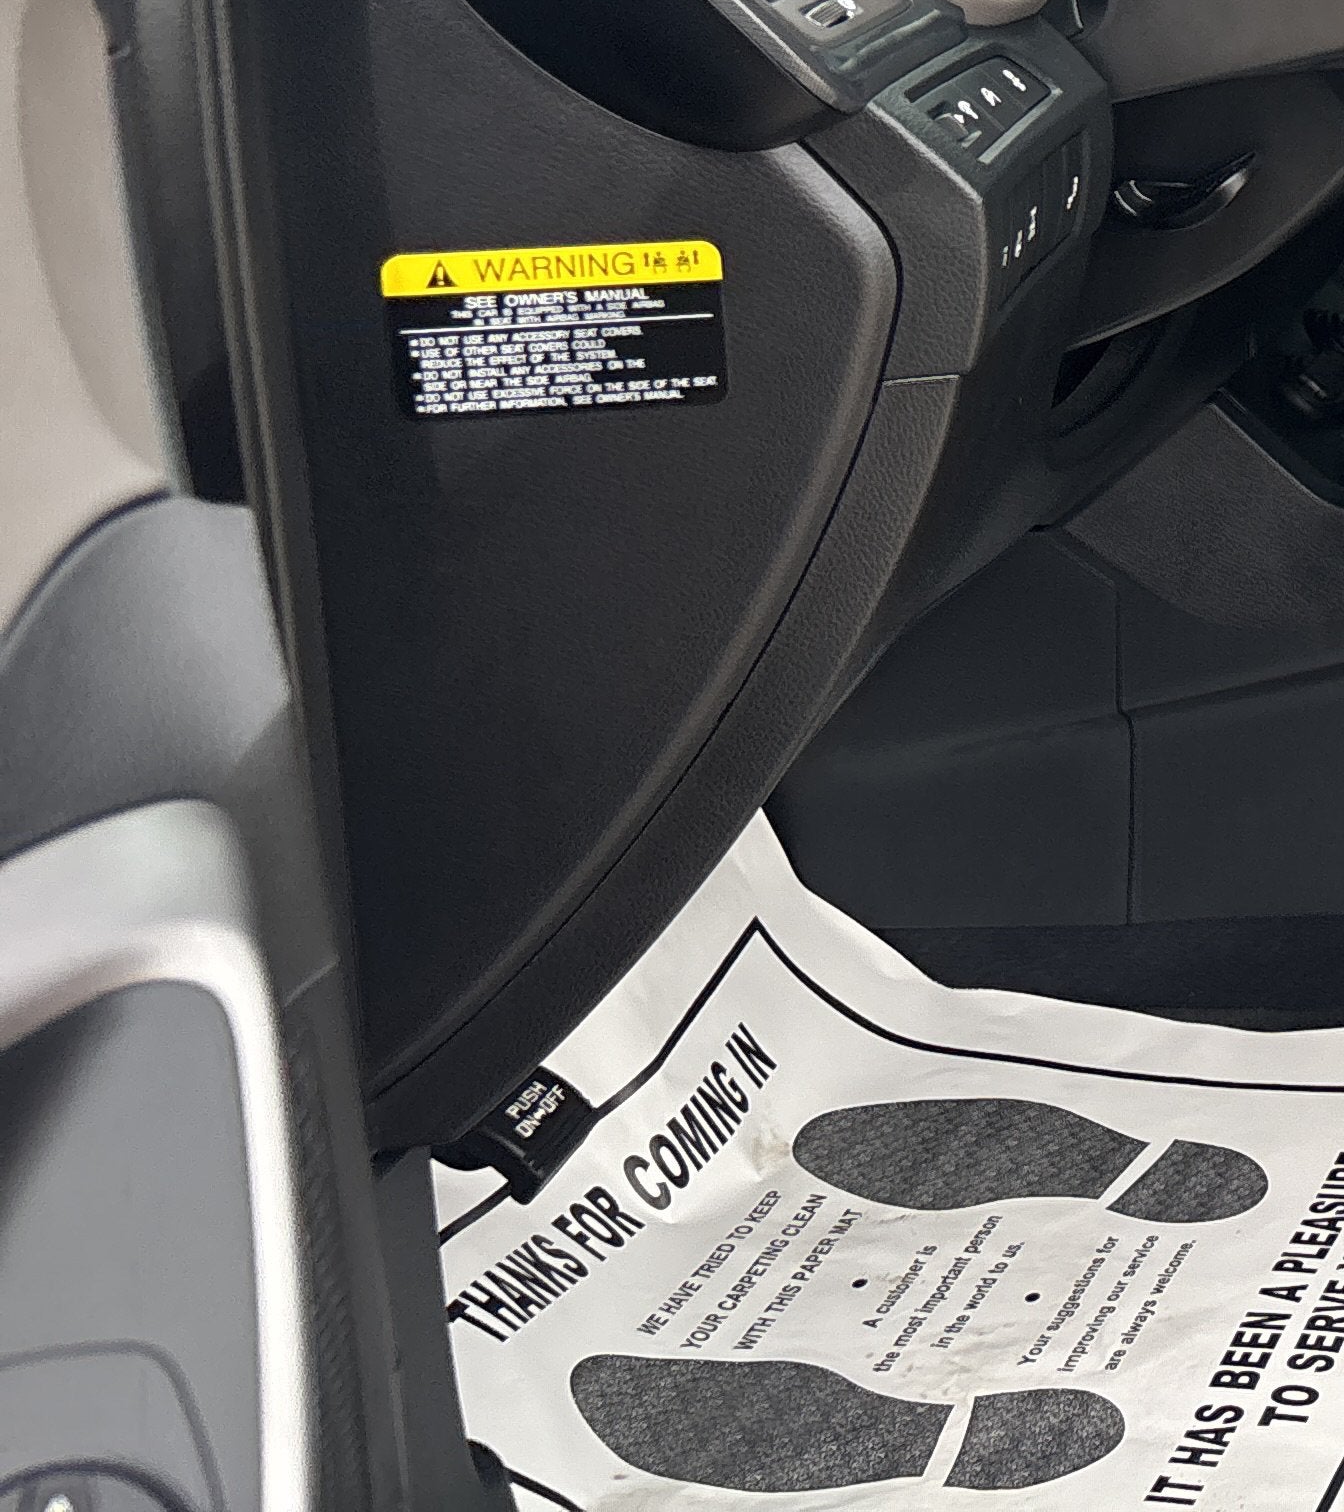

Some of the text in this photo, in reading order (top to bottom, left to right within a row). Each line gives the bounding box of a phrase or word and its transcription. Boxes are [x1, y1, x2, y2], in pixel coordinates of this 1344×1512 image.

[464, 288, 648, 308] SEE OWNER'S MANUAL
[474, 251, 635, 283] WARNING
[505, 1081, 547, 1119] PUSH
[446, 1023, 777, 1342] THANKS FOR COMING IN
[637, 1190, 781, 1335] WE HAVE TRIED TO KEEP
[680, 1194, 827, 1348] YOUR CARPETING CLEAN
[733, 1209, 862, 1350] WITH THIS PAPER MAT
[862, 1245, 937, 1328] A customer is
[873, 1216, 1002, 1372] the most important person
[930, 1242, 1025, 1348] in the world to us.
[1017, 1236, 1119, 1365] Your suggestions for
[1057, 1235, 1159, 1372] improving our service
[1105, 1240, 1196, 1370] are always welcome.
[1259, 1284, 1309, 1303] A
[1209, 1312, 1293, 1390] BEEN
[1168, 1404, 1244, 1468] HAS
[1257, 1385, 1319, 1427] TO
[1144, 1475, 1204, 1505] IT
